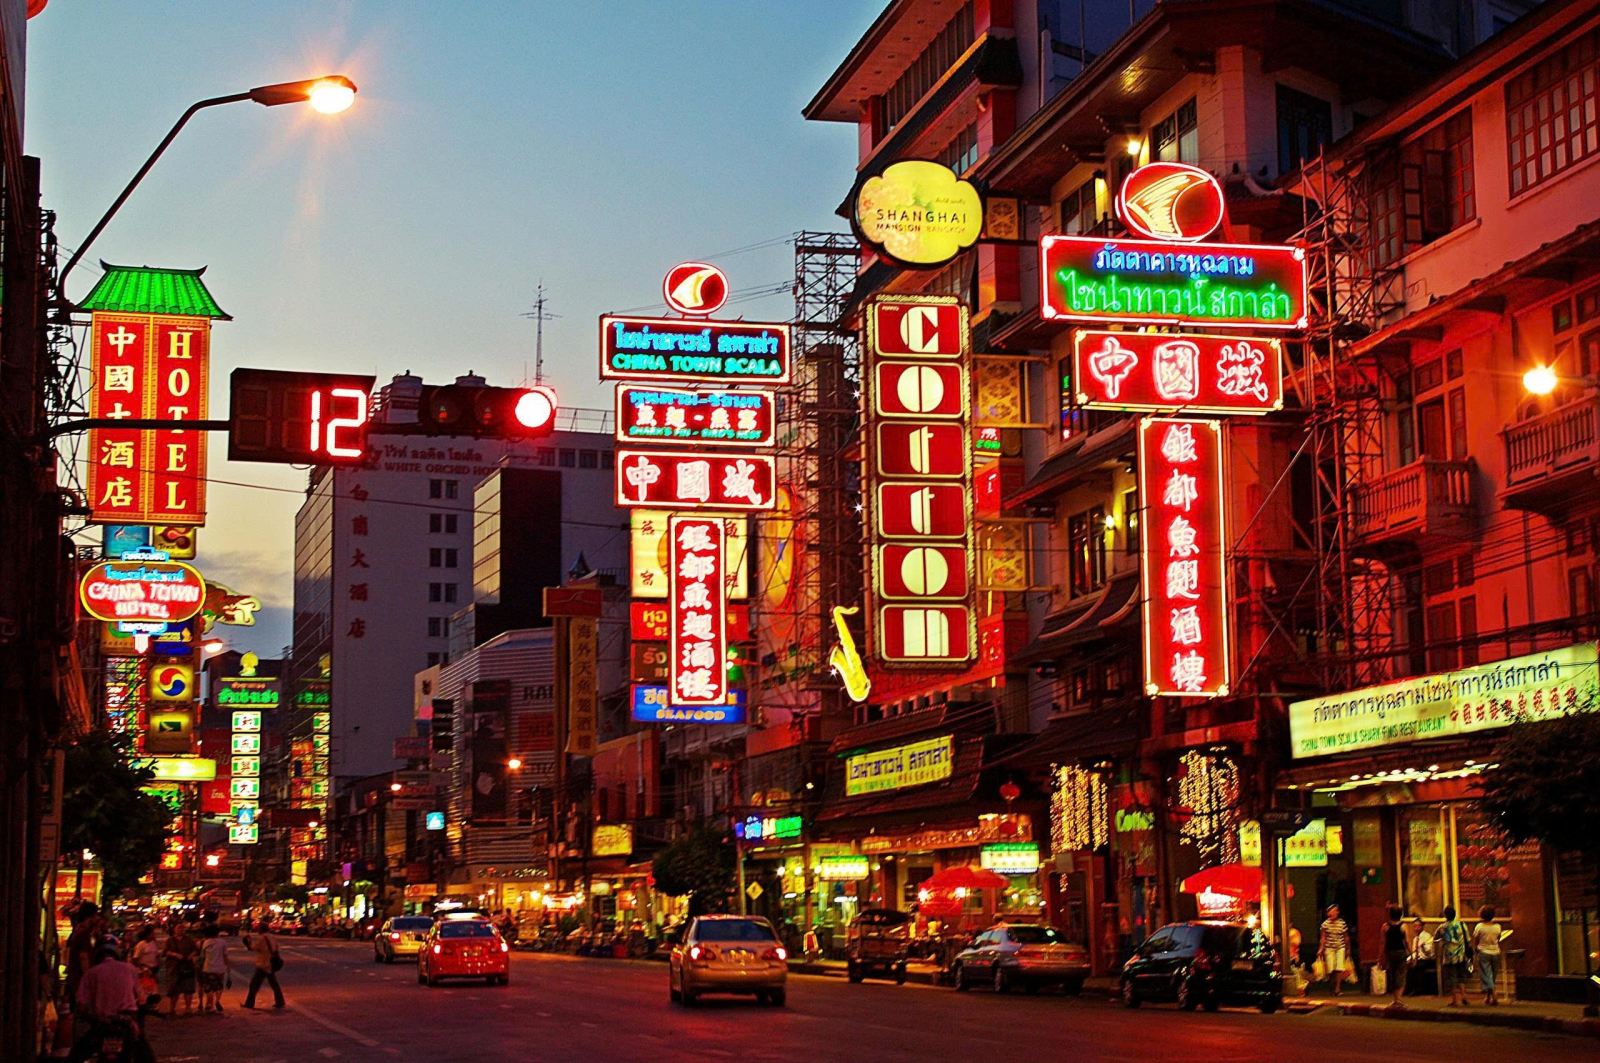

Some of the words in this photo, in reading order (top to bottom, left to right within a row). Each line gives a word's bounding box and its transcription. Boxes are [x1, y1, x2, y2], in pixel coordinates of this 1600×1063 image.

[876, 208, 966, 224] SHANGHAI
[876, 223, 921, 232] MANSION
[1096, 243, 1254, 279] ภัตตาคารหูฉลาม
[612, 353, 667, 371] CHINA
[669, 355, 722, 373] TOWN
[724, 357, 782, 375] SCALA
[165, 331, 194, 510] HOTEL
[310, 387, 367, 458] 12
[384, 462, 421, 473] WHITE
[425, 463, 471, 475] ORCHID
[625, 455, 762, 505] 中國城
[88, 582, 145, 602] CHINA
[150, 583, 200, 603] TOWN
[114, 601, 170, 619] HOTEL
[655, 708, 726, 721] SEAFOOD
